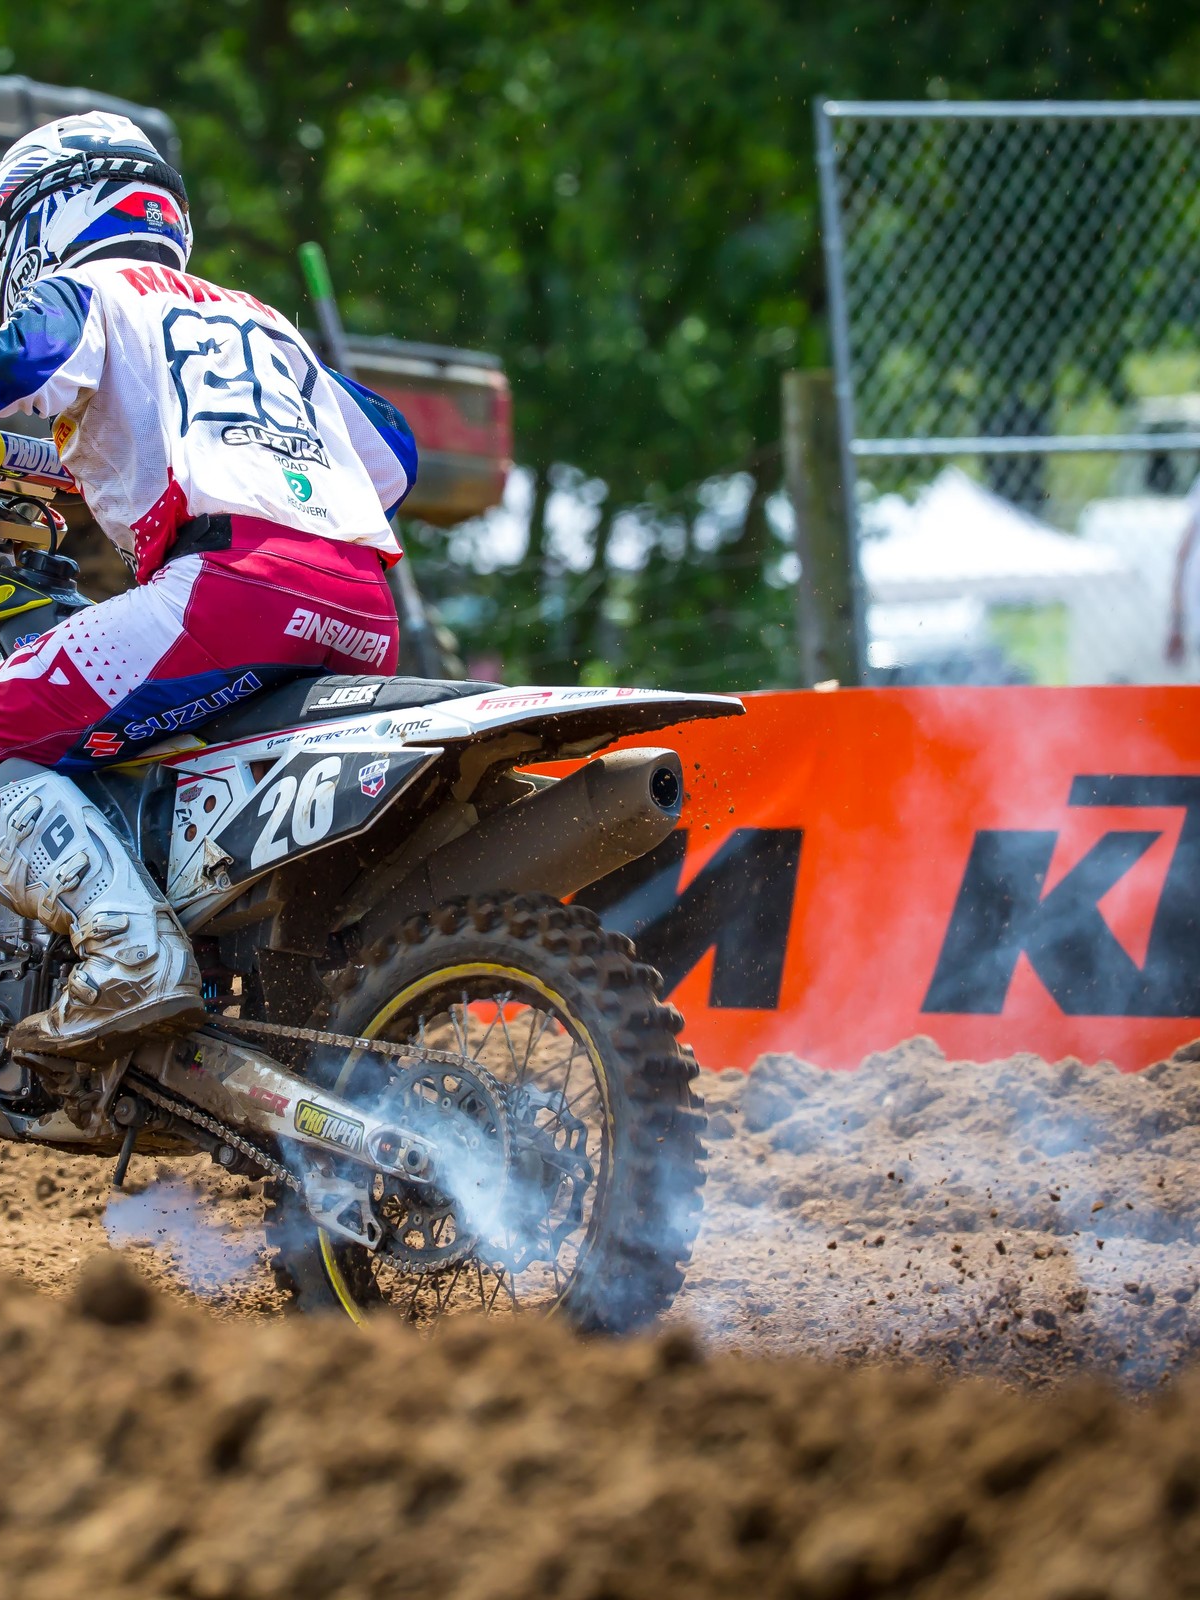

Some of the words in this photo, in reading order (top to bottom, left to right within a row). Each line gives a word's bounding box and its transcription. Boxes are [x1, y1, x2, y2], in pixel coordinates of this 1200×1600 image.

[9, 158, 153, 220] SCOTT
[146, 210, 163, 221] DOT
[2, 435, 64, 475] PROTA
[221, 425, 331, 470] SUZUKI
[273, 454, 309, 472] ROAD
[290, 479, 306, 498] 2
[287, 495, 327, 518] RECOVERY
[124, 671, 263, 740] SUZUKI
[317, 684, 382, 705] JGR
[476, 691, 553, 711] PIRELLI
[304, 724, 372, 746] MARTIN
[390, 718, 433, 735] KMC
[250, 755, 342, 871] 26
